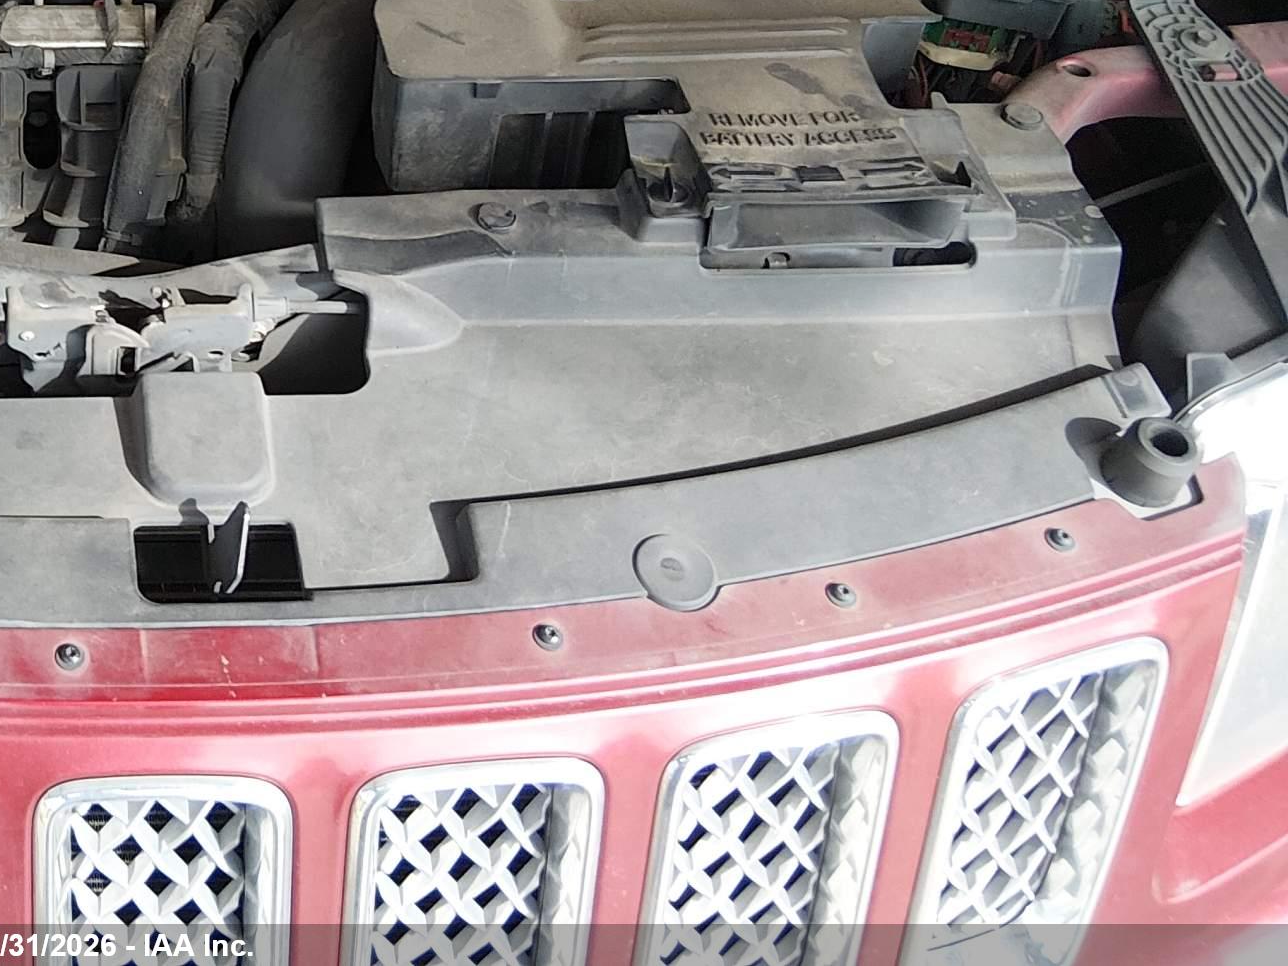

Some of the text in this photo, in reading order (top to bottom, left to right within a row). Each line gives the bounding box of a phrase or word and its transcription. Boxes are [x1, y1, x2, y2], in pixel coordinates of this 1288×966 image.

[709, 110, 861, 127] REMOVE FOR
[700, 128, 897, 147] BATTERY ACCESS
